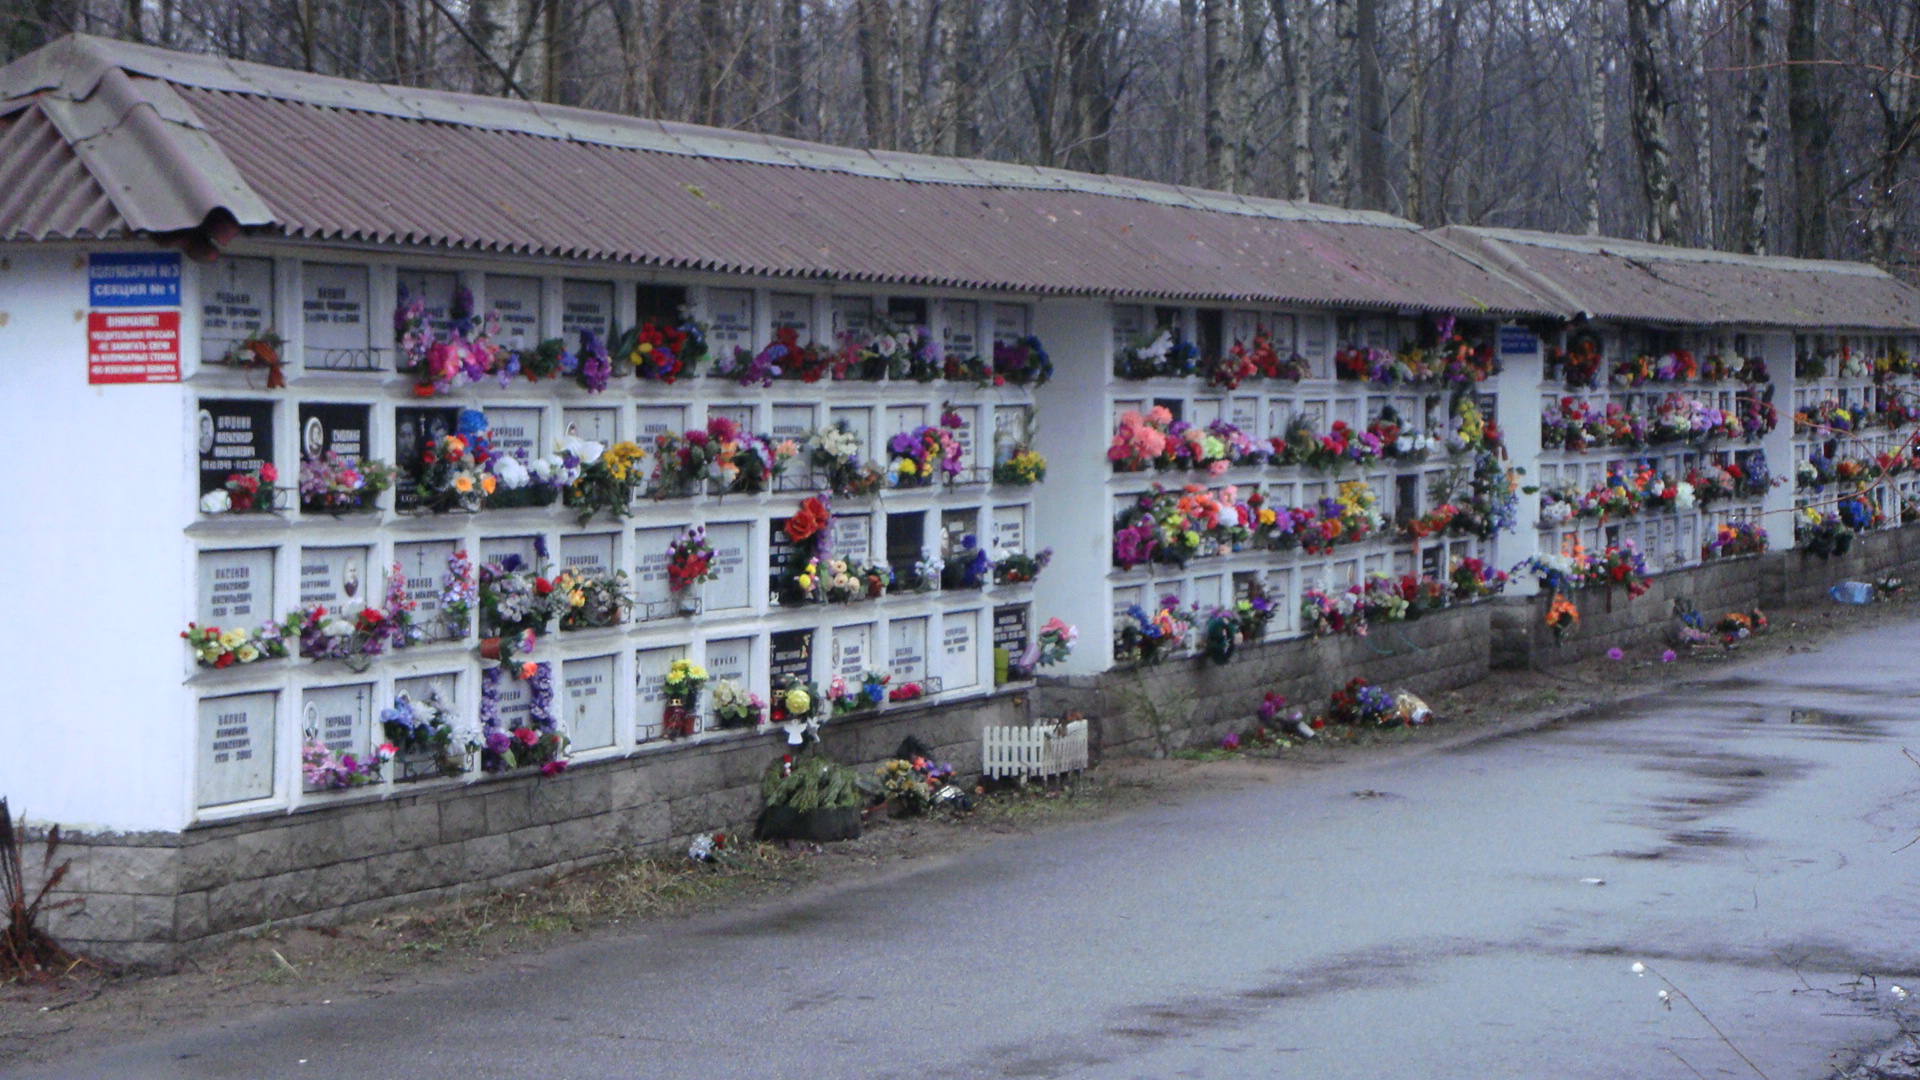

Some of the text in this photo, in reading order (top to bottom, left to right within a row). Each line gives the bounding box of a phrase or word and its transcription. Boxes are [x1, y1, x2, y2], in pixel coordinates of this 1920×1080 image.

[93, 284, 147, 297] СЕКЦИЯ
[169, 284, 176, 294] 1
[106, 315, 159, 328] ВНИМАНИЕ!
